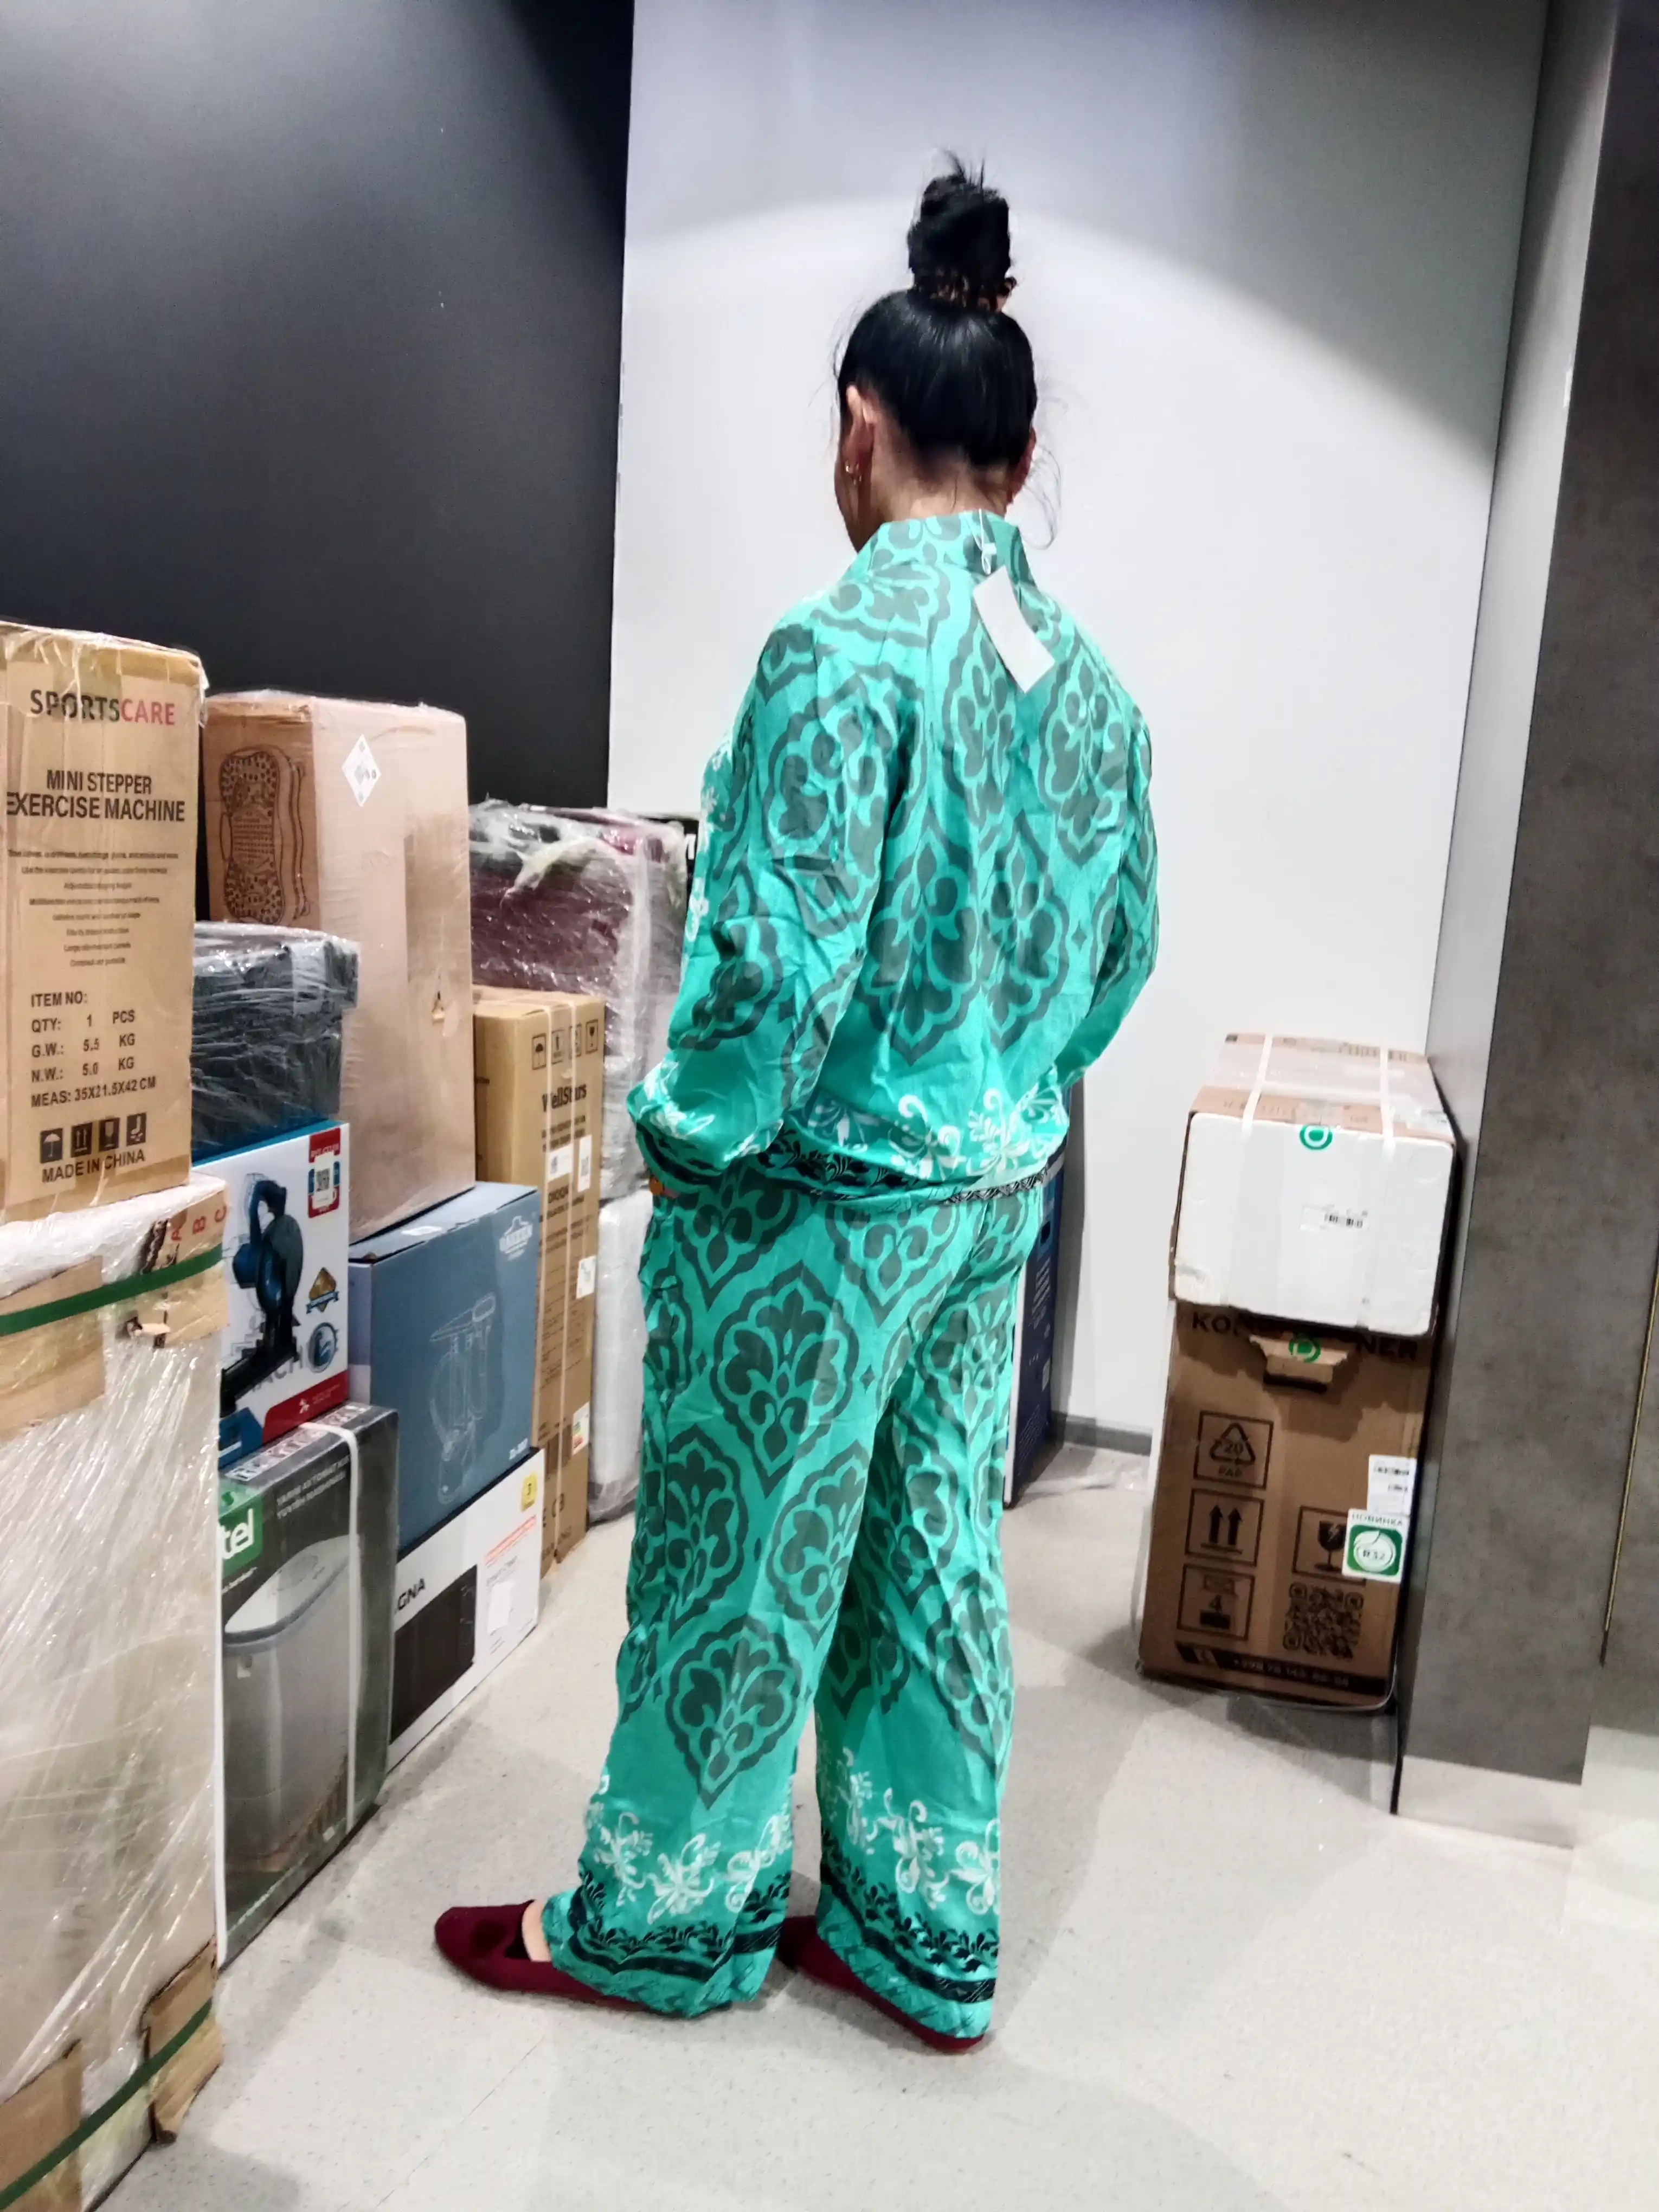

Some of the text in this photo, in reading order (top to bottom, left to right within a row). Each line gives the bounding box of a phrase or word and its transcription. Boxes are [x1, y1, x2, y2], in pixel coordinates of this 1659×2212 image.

[30, 689, 176, 725] SPORTSCARE
[47, 769, 151, 794] MINI STEPPER
[7, 792, 185, 822] EXERCISE MACHINE
[31, 991, 87, 1007] ITEM NO:
[31, 1009, 135, 1033] QTY: 1 PCS
[83, 1038, 100, 1051] 5.5
[119, 1033, 136, 1047] KG
[82, 1062, 99, 1076] 5.0
[118, 1057, 134, 1071] KG
[31, 1090, 71, 1107] MEAS:
[139, 1076, 157, 1090] CM
[42, 1149, 145, 1183] MADE IN CHINA
[395, 1578, 425, 1612] GNA
